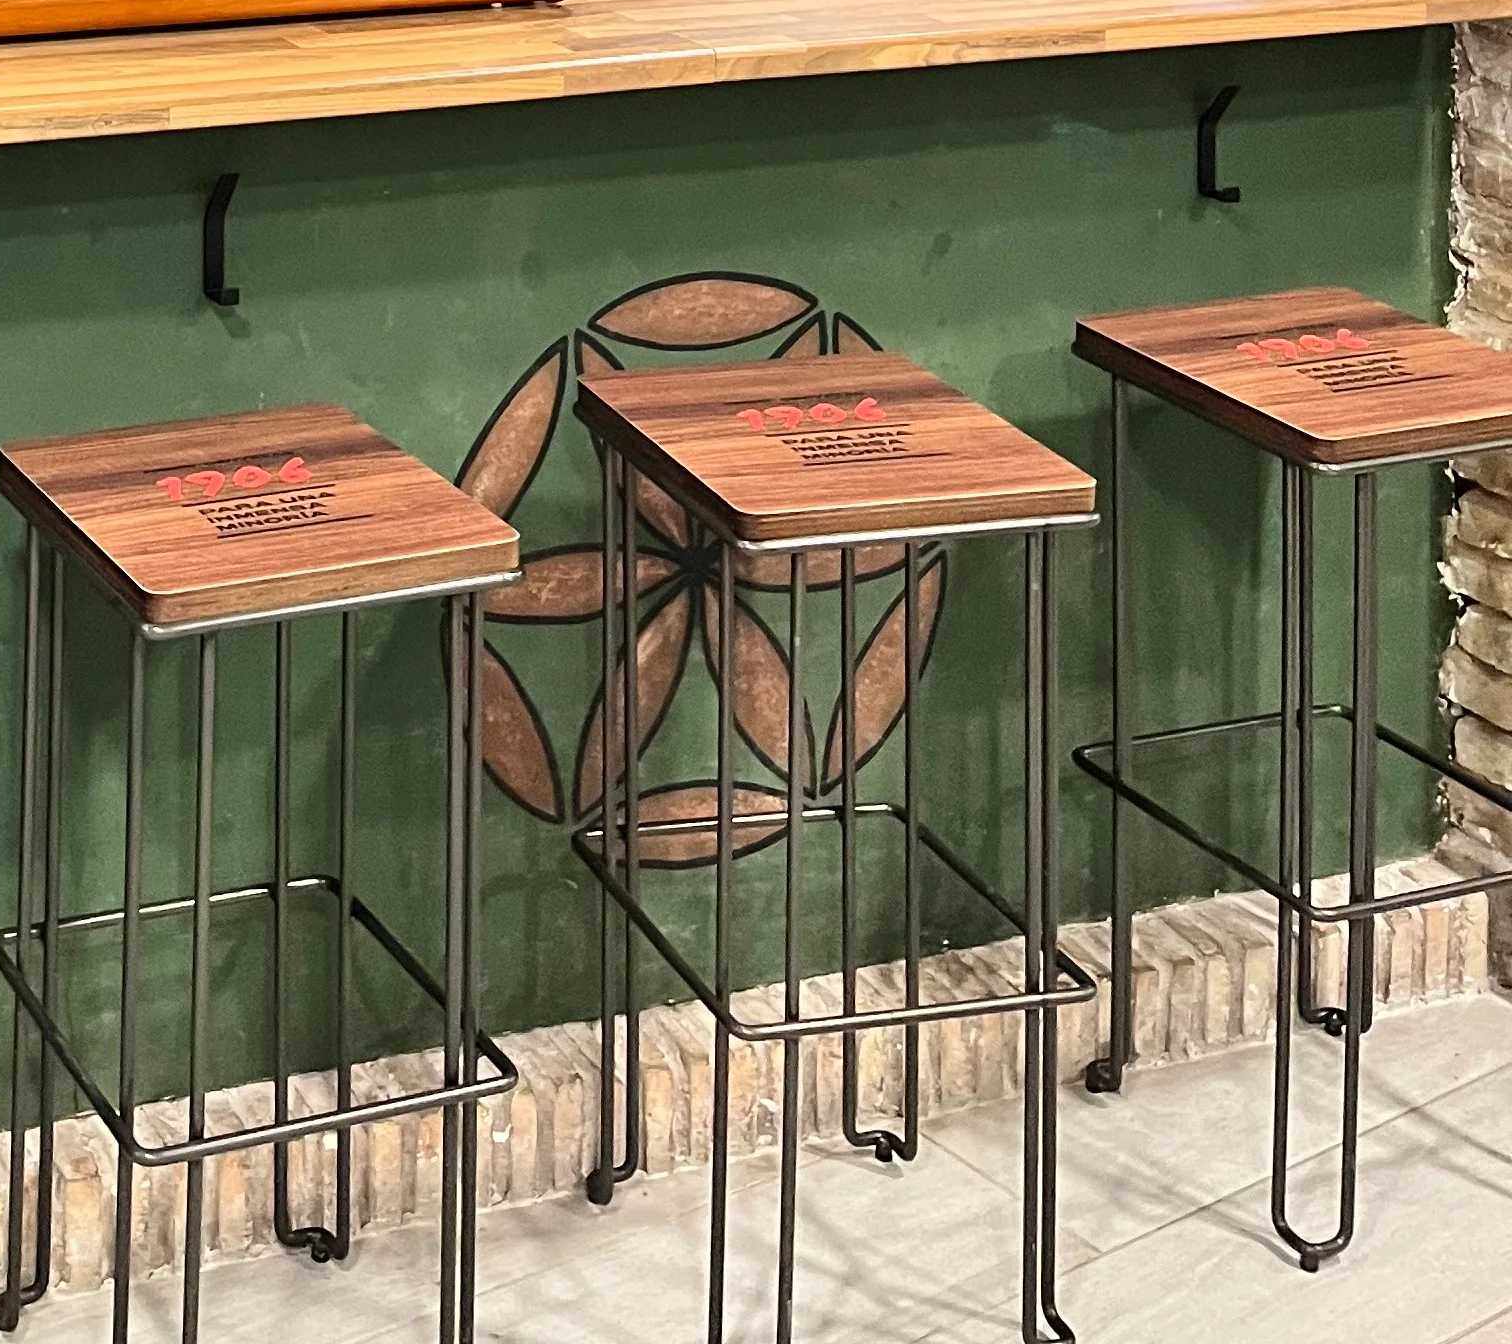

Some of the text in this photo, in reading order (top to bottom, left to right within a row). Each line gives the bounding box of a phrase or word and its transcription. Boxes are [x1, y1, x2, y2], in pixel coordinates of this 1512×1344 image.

[737, 397, 887, 432] 1906
[156, 456, 314, 501] 1906
[198, 491, 337, 515] PARA UNA
[207, 501, 327, 524] INMENSA
